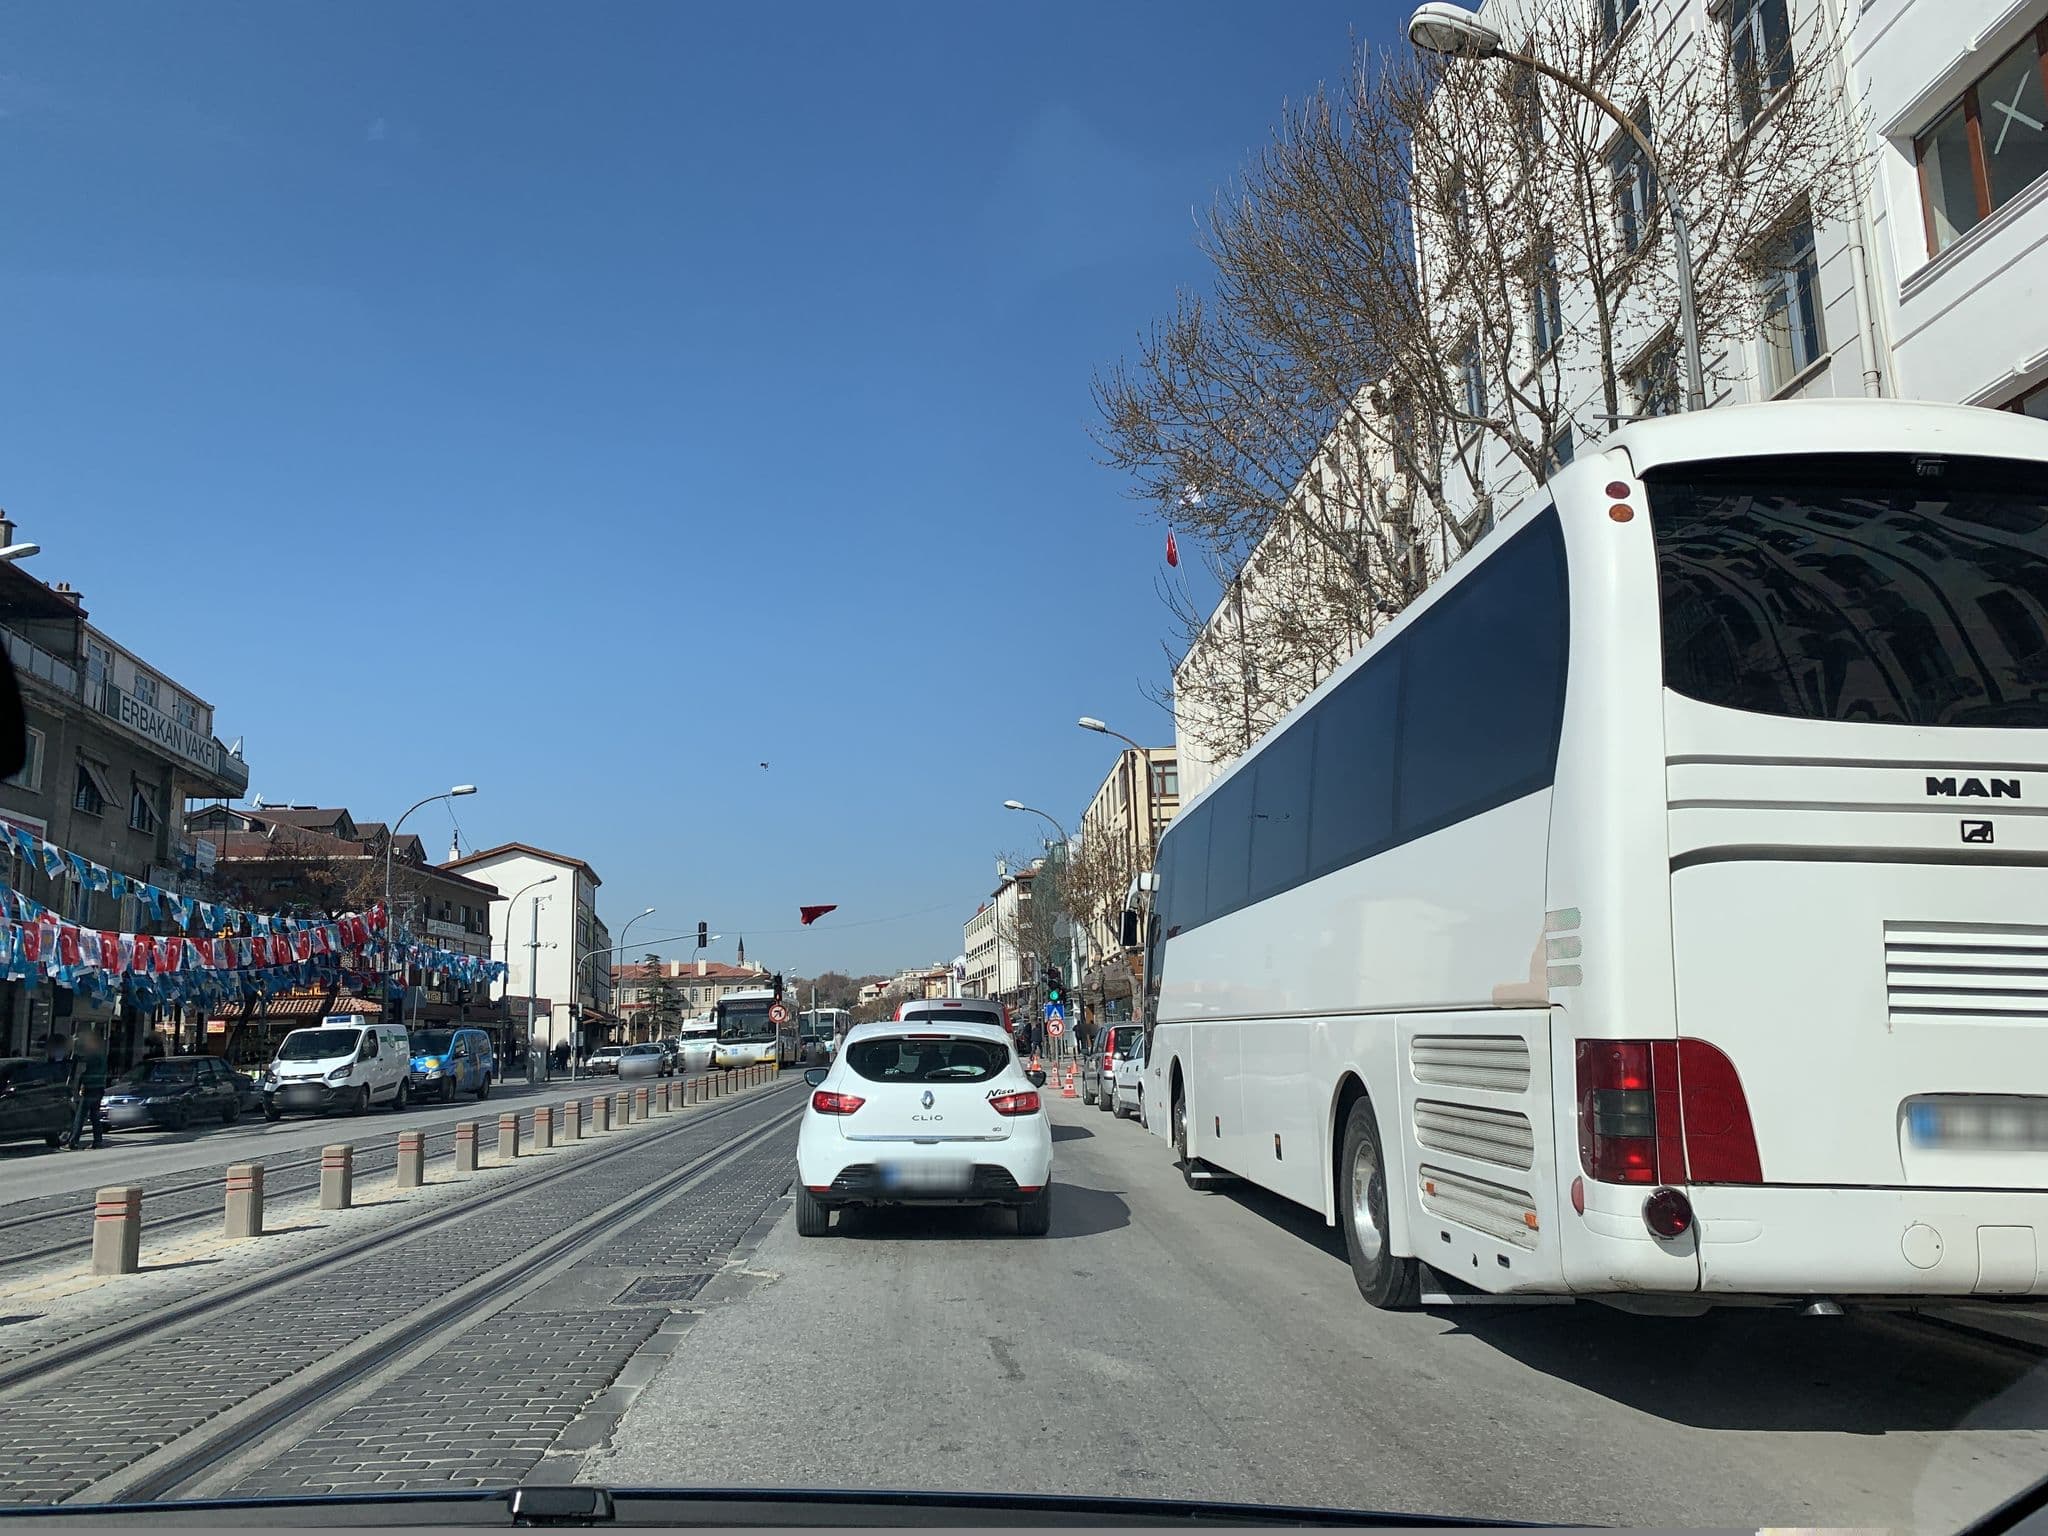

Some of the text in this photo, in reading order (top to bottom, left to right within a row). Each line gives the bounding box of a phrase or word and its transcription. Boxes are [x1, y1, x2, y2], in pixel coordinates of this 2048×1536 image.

[122, 696, 216, 768] ERBAKAN VAKFI
[1926, 777, 2020, 799] MAN
[985, 1089, 1014, 1099] Nisa
